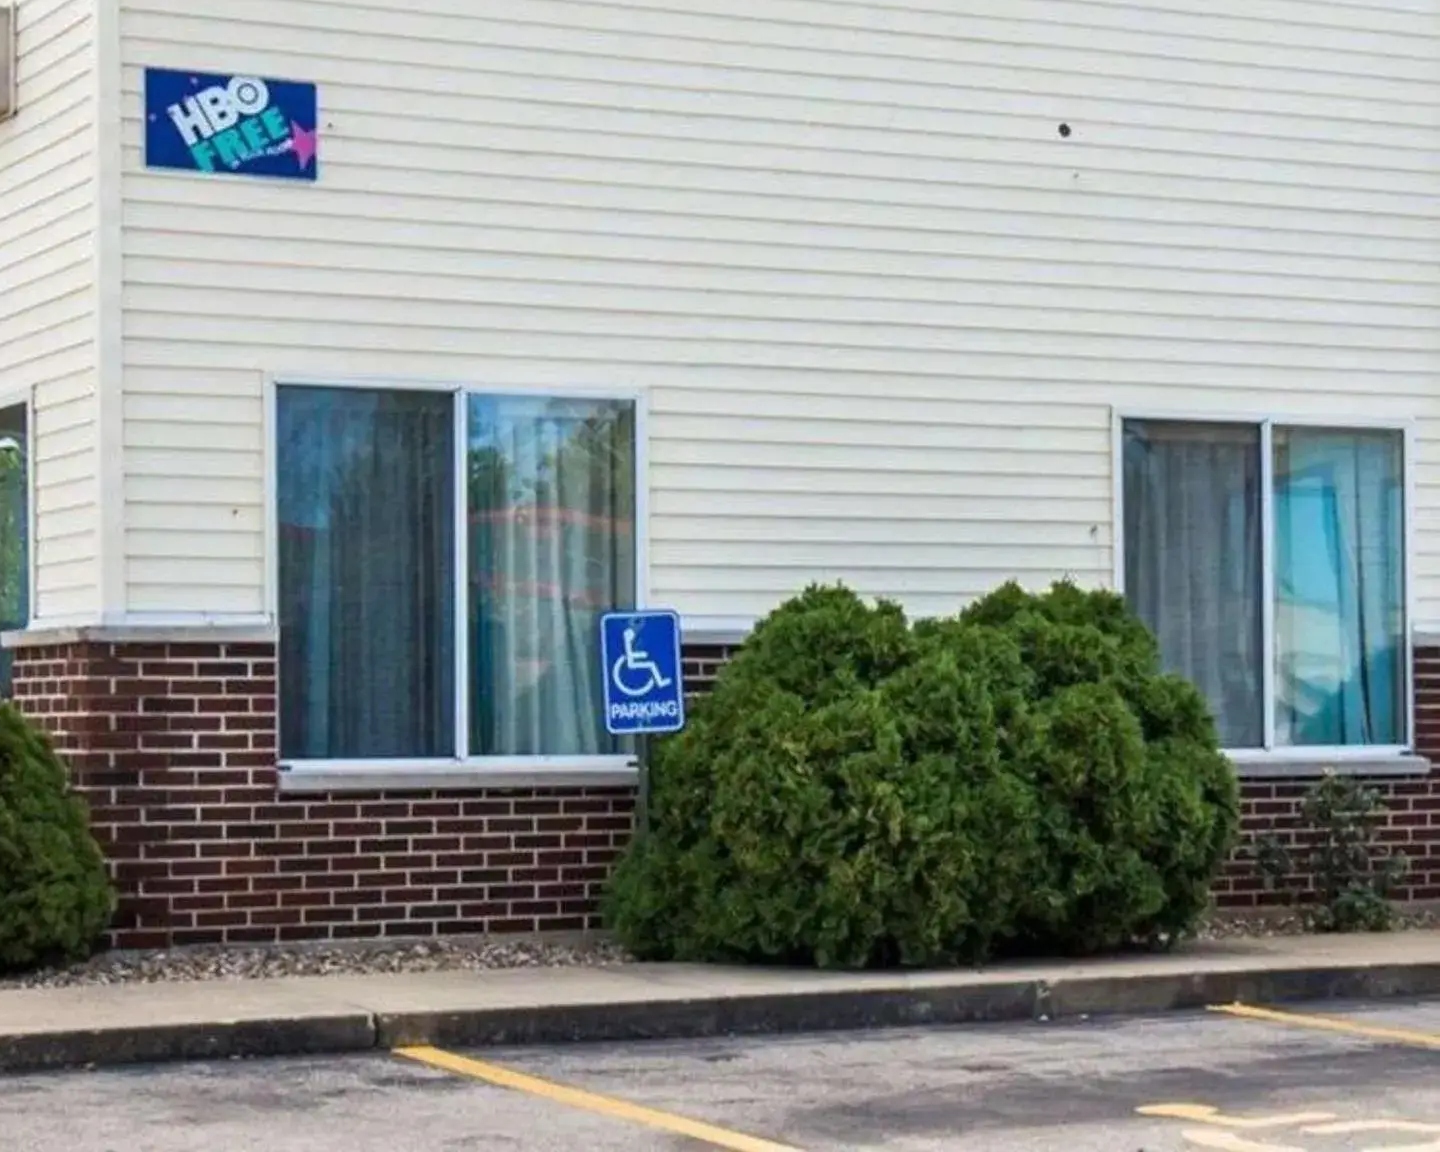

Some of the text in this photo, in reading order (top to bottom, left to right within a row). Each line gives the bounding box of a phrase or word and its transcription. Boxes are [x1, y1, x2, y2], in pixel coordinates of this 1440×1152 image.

[167, 76, 269, 146] HBO
[191, 106, 289, 173] FREE
[612, 700, 676, 719] PARKING
